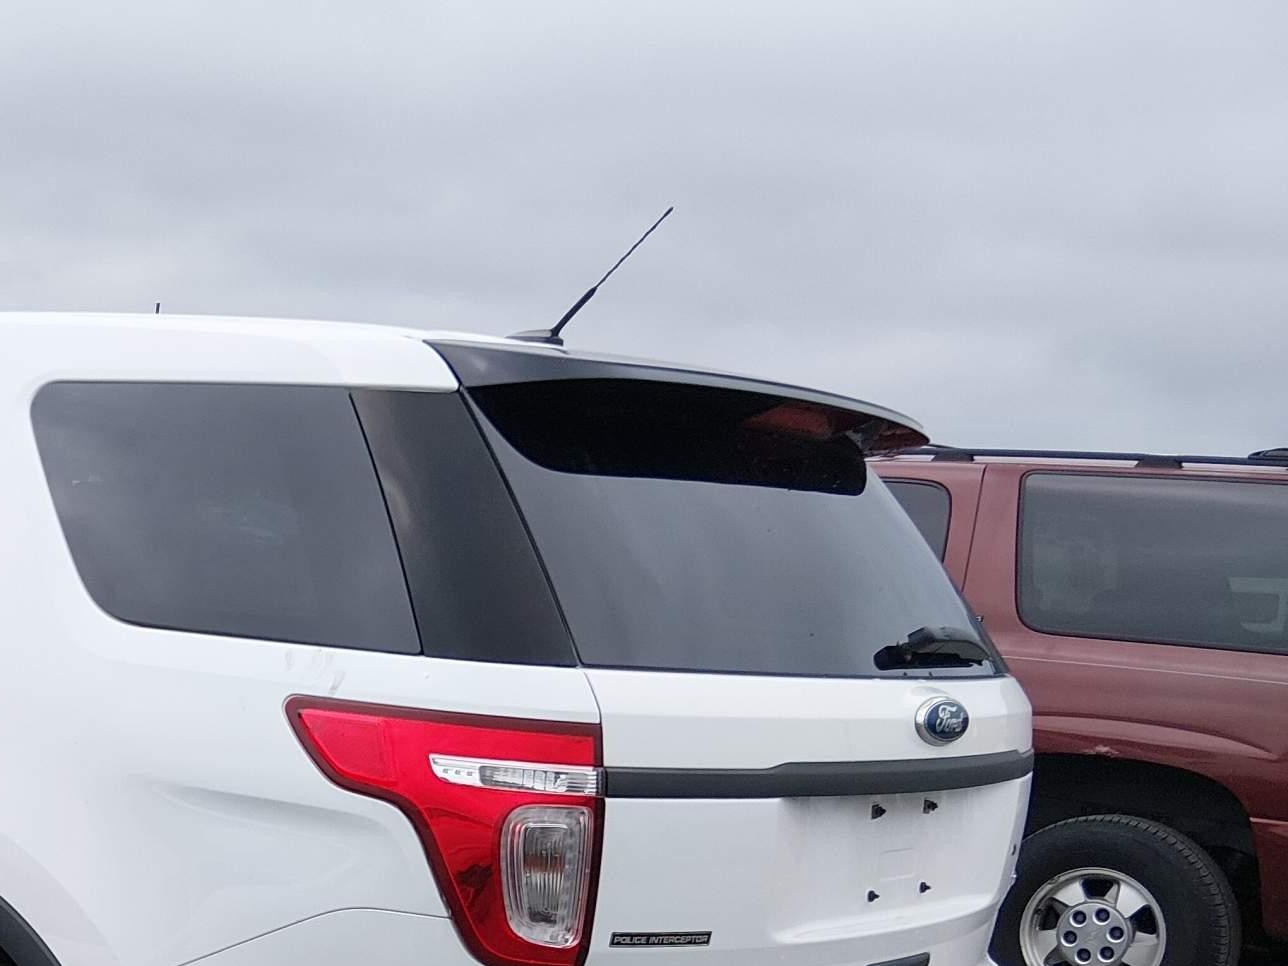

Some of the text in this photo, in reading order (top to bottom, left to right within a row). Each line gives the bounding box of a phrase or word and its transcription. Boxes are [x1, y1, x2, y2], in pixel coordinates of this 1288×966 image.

[935, 705, 964, 733] Ford
[613, 935, 708, 944] POLICE INTERCEPTOR
